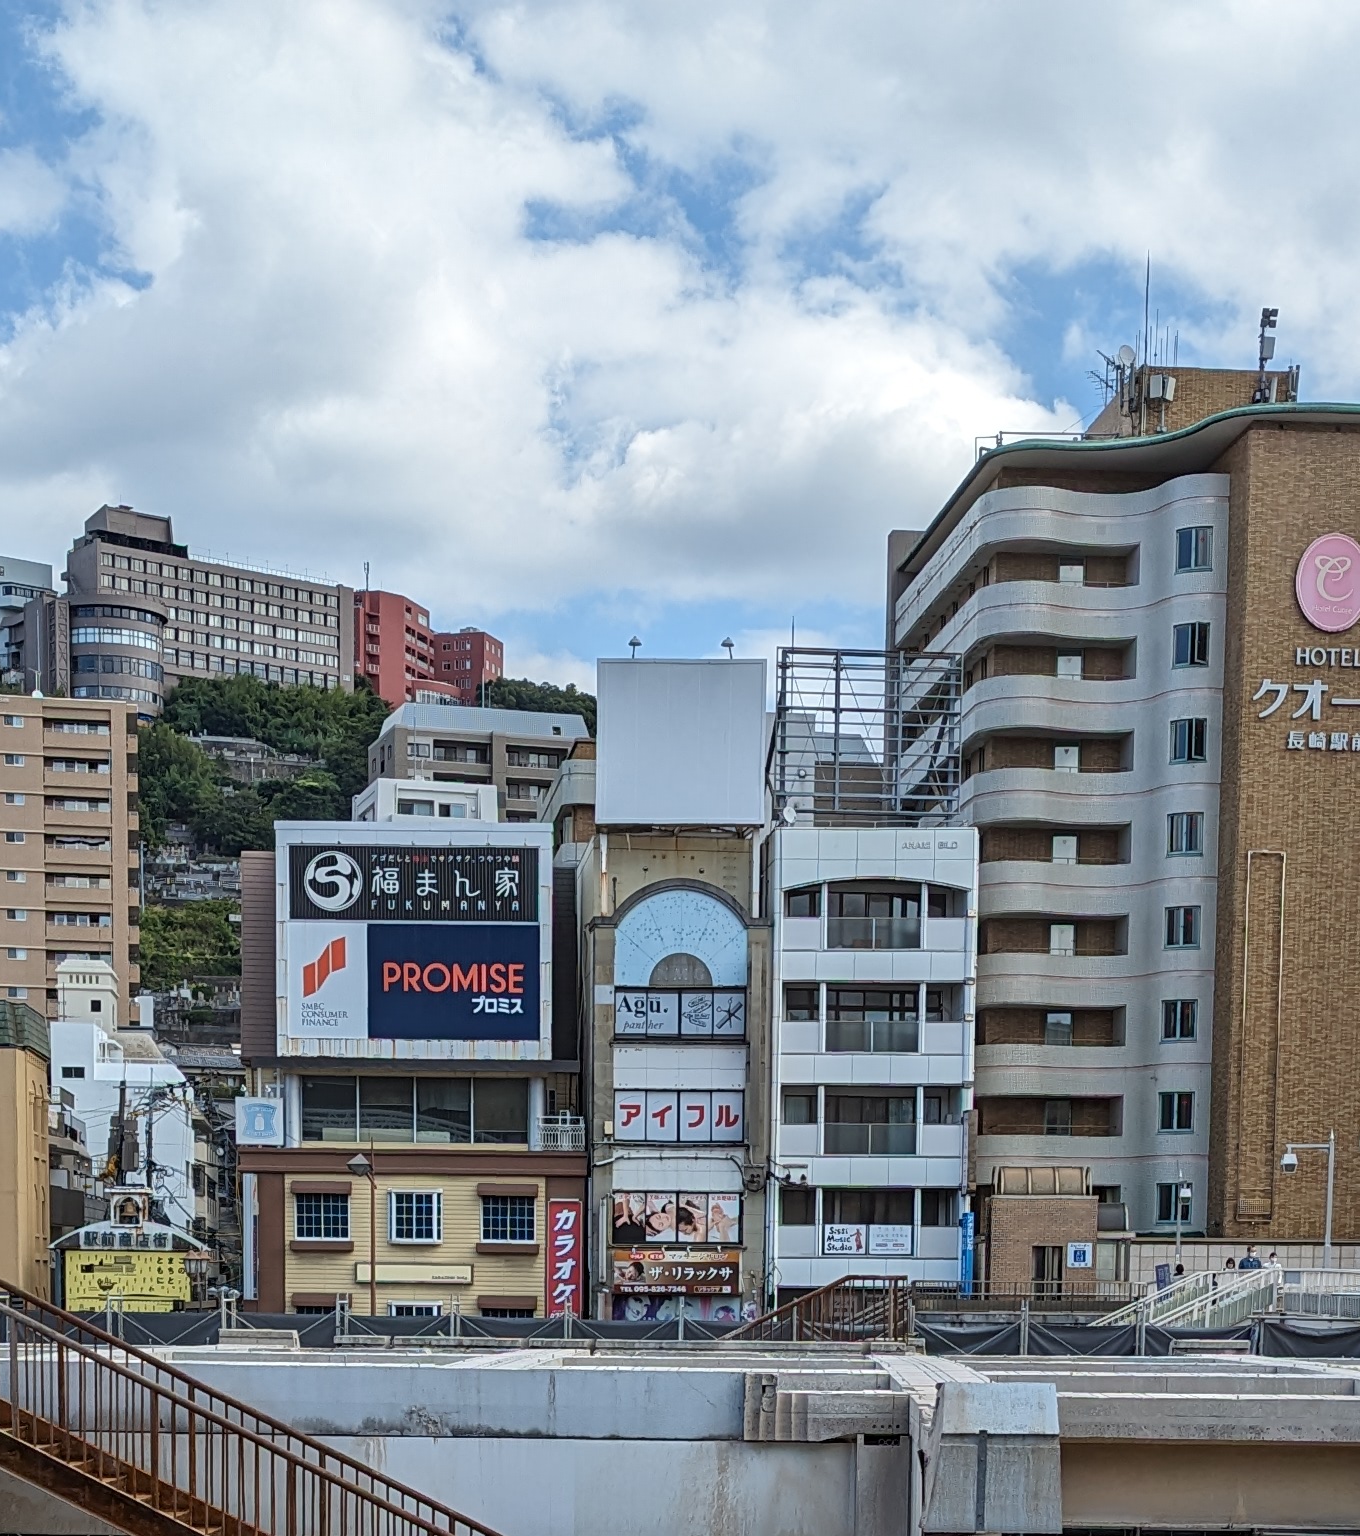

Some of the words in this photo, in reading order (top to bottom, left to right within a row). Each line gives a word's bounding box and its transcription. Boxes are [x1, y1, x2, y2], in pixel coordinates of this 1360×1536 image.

[1312, 604, 1331, 612] Hotel
[371, 866, 519, 897] 福まん家
[371, 900, 520, 911] FUKUMANYA
[383, 962, 525, 994] PROMISE
[471, 996, 524, 1014] プロミス
[301, 1011, 348, 1019] CONSUMER
[301, 1019, 339, 1027] FINANCE
[619, 1104, 740, 1128] アイフル
[84, 1231, 168, 1247] 駅前商店街
[826, 1242, 853, 1252] Studio
[552, 1209, 577, 1304] カラオケ
[648, 1267, 734, 1281] ザ・リラックサ
